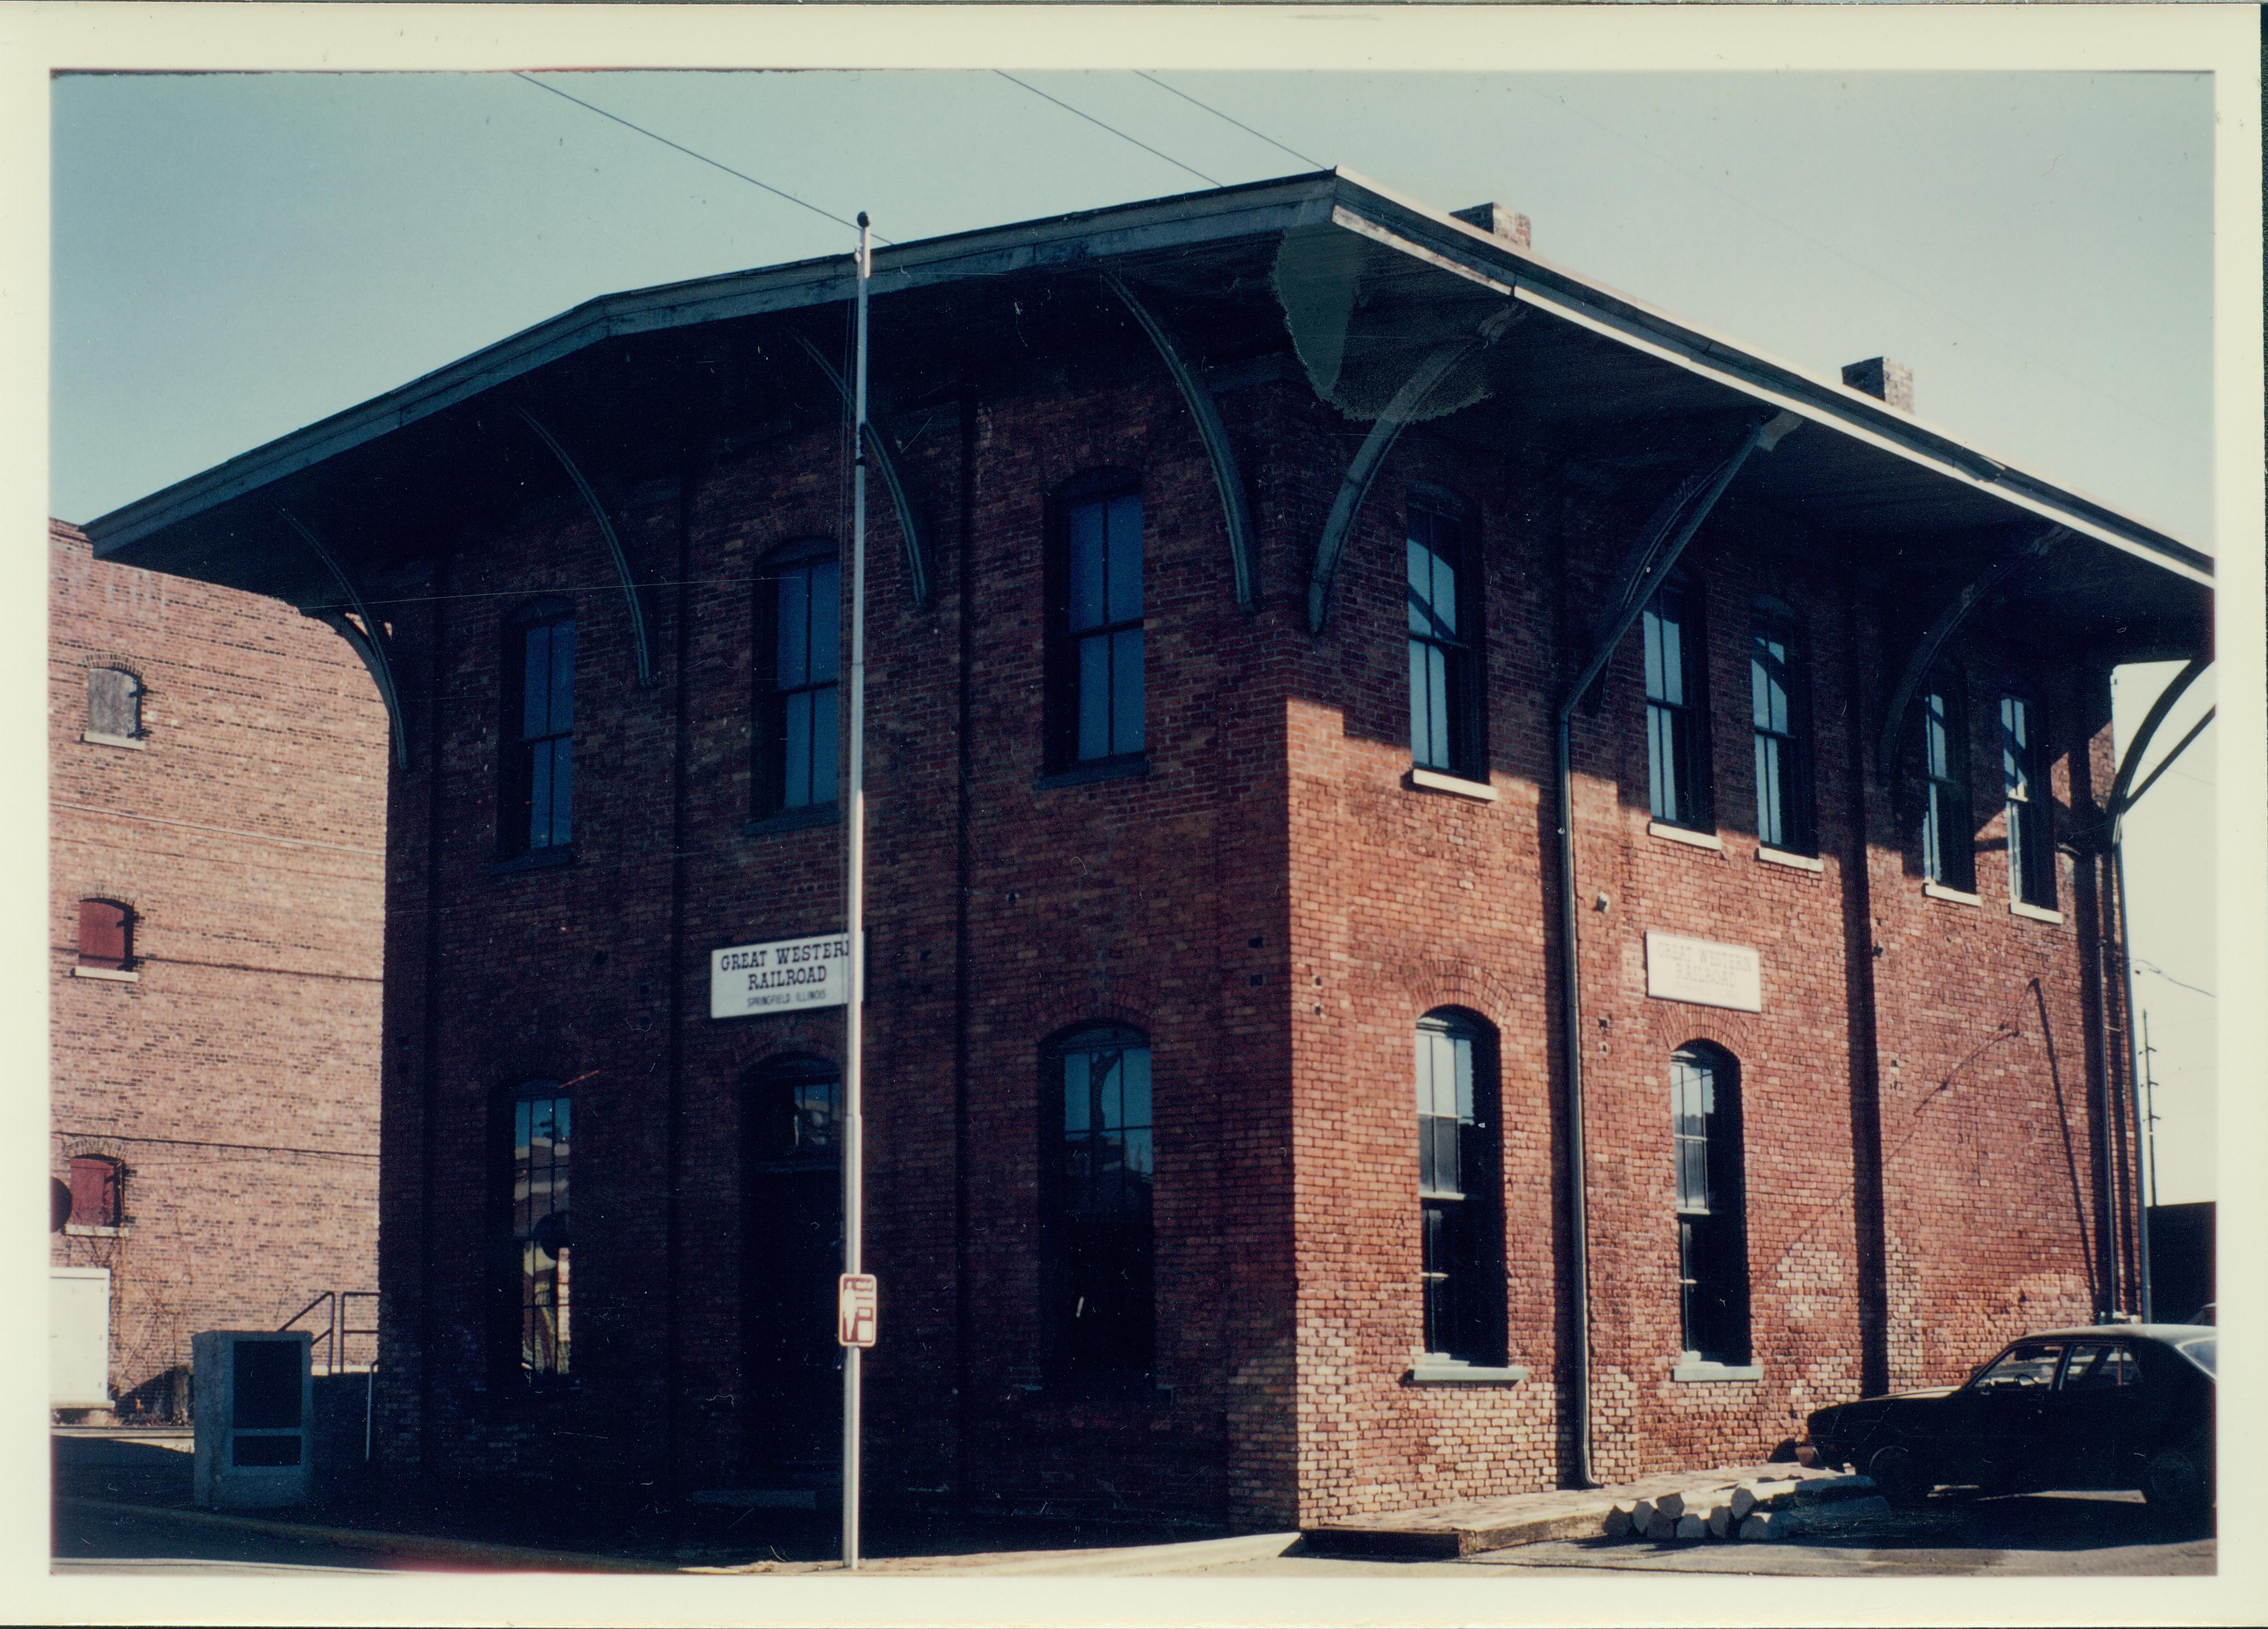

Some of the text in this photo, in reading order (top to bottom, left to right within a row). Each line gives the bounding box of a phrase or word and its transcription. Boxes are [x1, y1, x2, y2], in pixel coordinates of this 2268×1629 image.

[721, 950, 767, 971] GREAT
[1657, 943, 1751, 972] GREAT WESTERN
[748, 965, 827, 991] RAILROAD
[1677, 963, 1735, 987] RAILROAD
